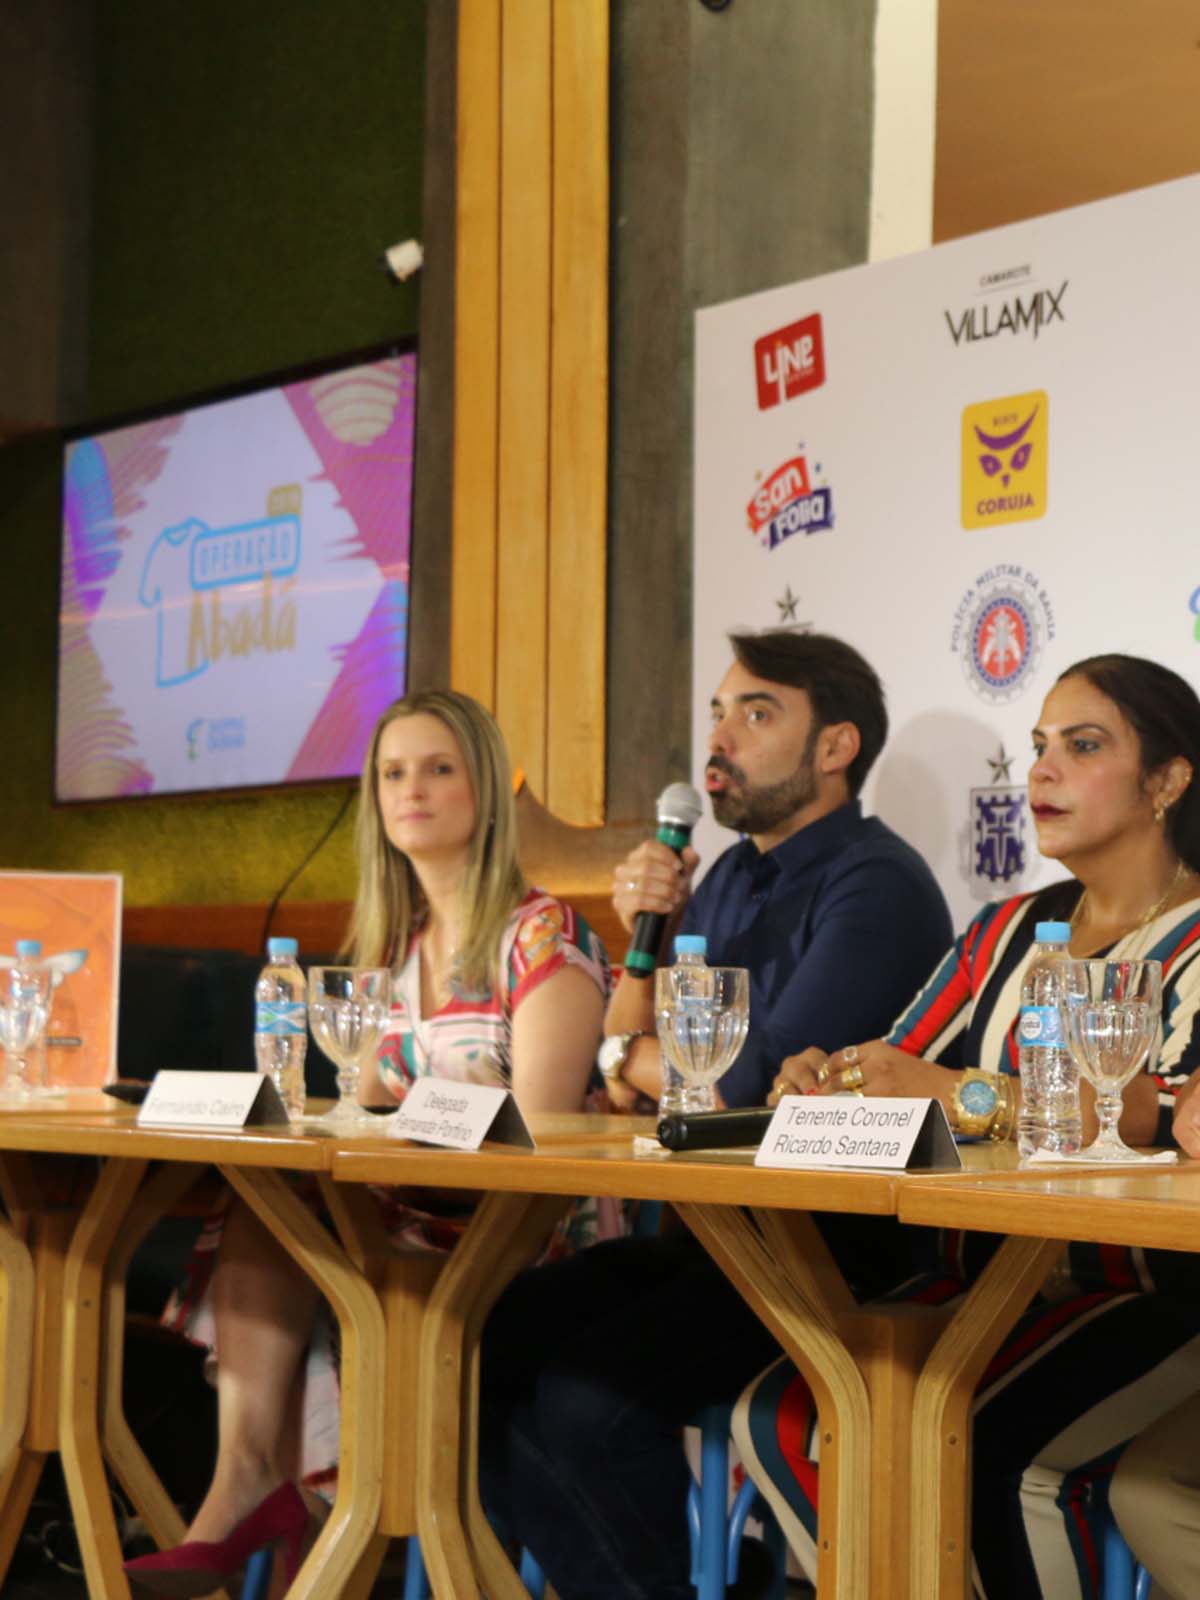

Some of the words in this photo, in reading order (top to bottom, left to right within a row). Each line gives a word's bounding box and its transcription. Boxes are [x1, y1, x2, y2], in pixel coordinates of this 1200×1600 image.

[944, 279, 1070, 347] VILLAMIX
[976, 493, 1035, 516] CORUJA
[200, 524, 292, 579] OPERAÇÃO
[976, 563, 1022, 587] MILITAR
[1024, 571, 1039, 591] DA
[1039, 588, 1056, 640] BAHIA
[786, 1105, 848, 1126] Tenente
[850, 1106, 915, 1128] Coronel
[772, 1133, 832, 1155] Ricardo
[834, 1136, 902, 1158] Santana
